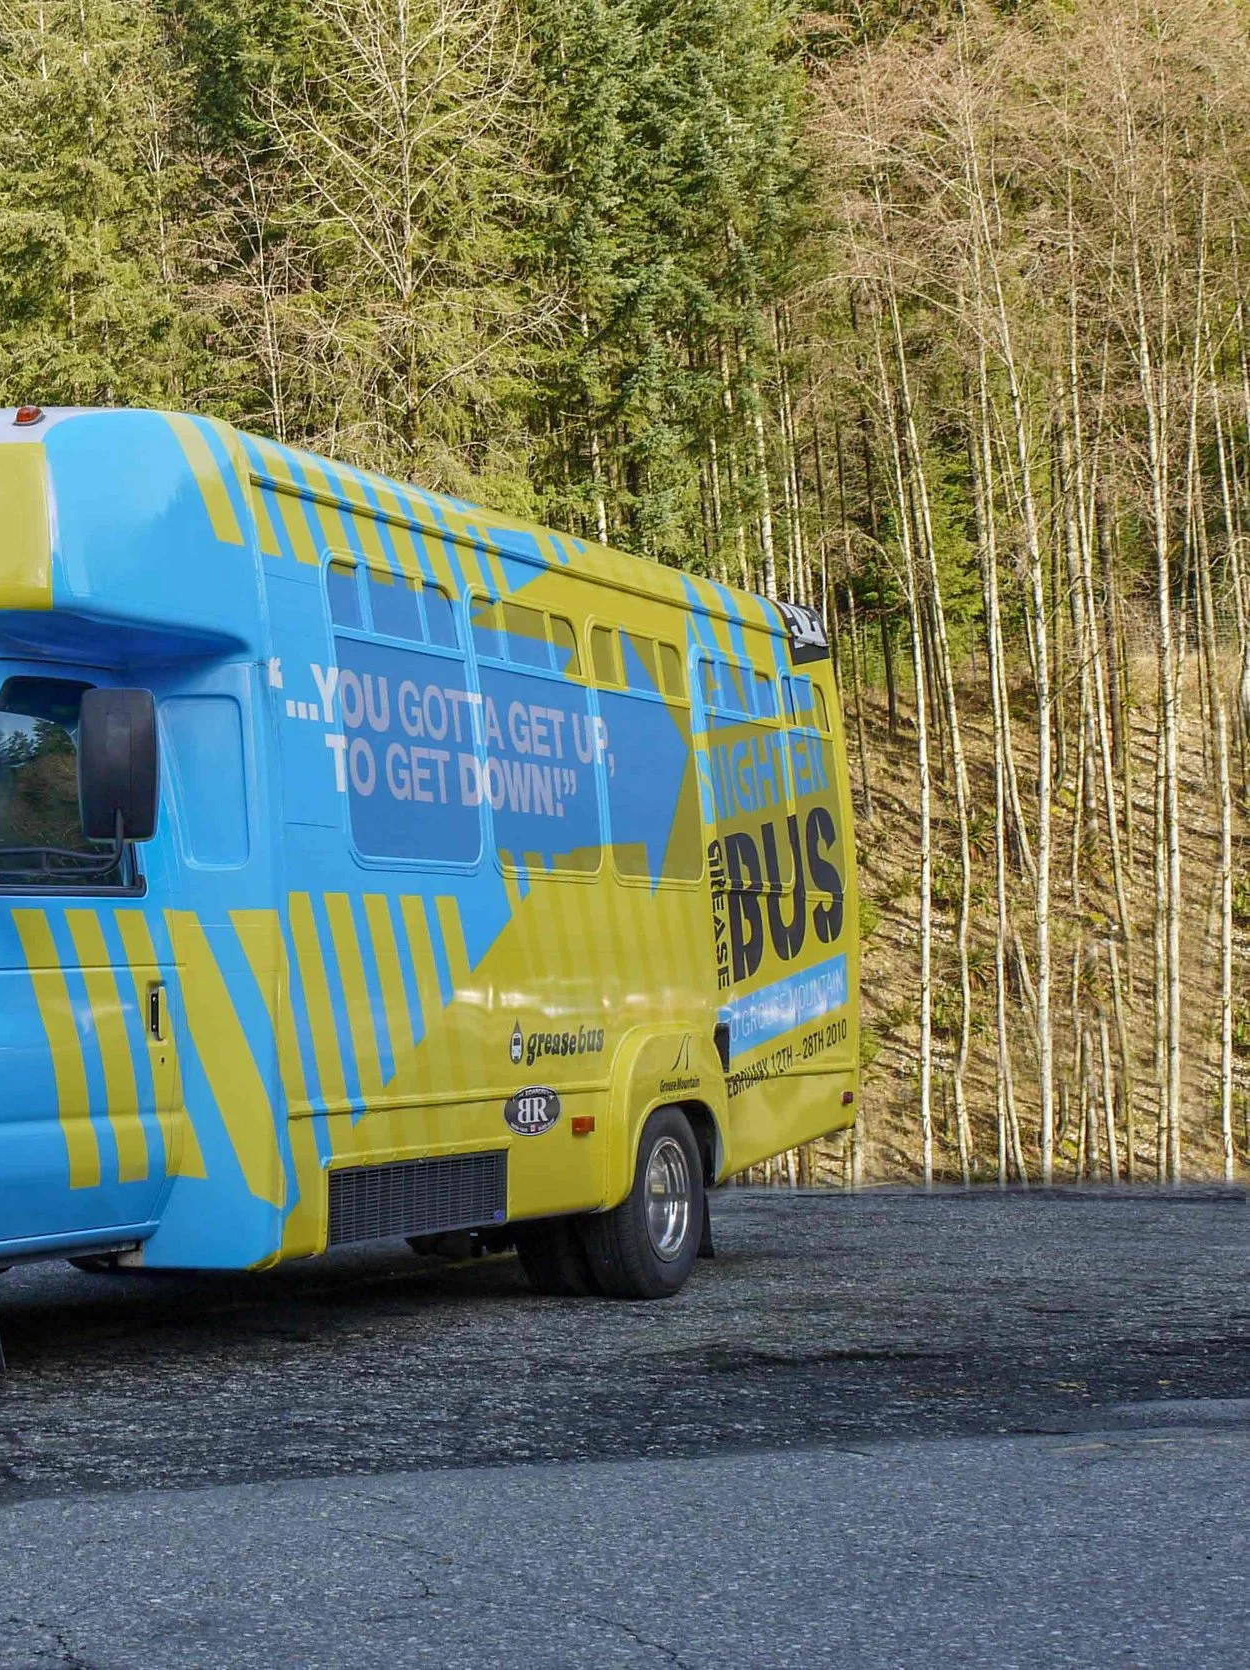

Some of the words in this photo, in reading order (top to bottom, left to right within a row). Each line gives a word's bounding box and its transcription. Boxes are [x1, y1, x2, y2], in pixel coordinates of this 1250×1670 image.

[397, 680, 505, 750] GOTTA
[508, 701, 565, 759] GET
[324, 732, 377, 797] TO
[386, 743, 451, 804] GET
[707, 840, 730, 990] GREASE
[724, 807, 844, 984] BUS
[771, 1045, 793, 1076] 12TH
[803, 1026, 824, 1059] 28TH
[826, 1018, 847, 1048] 2010
